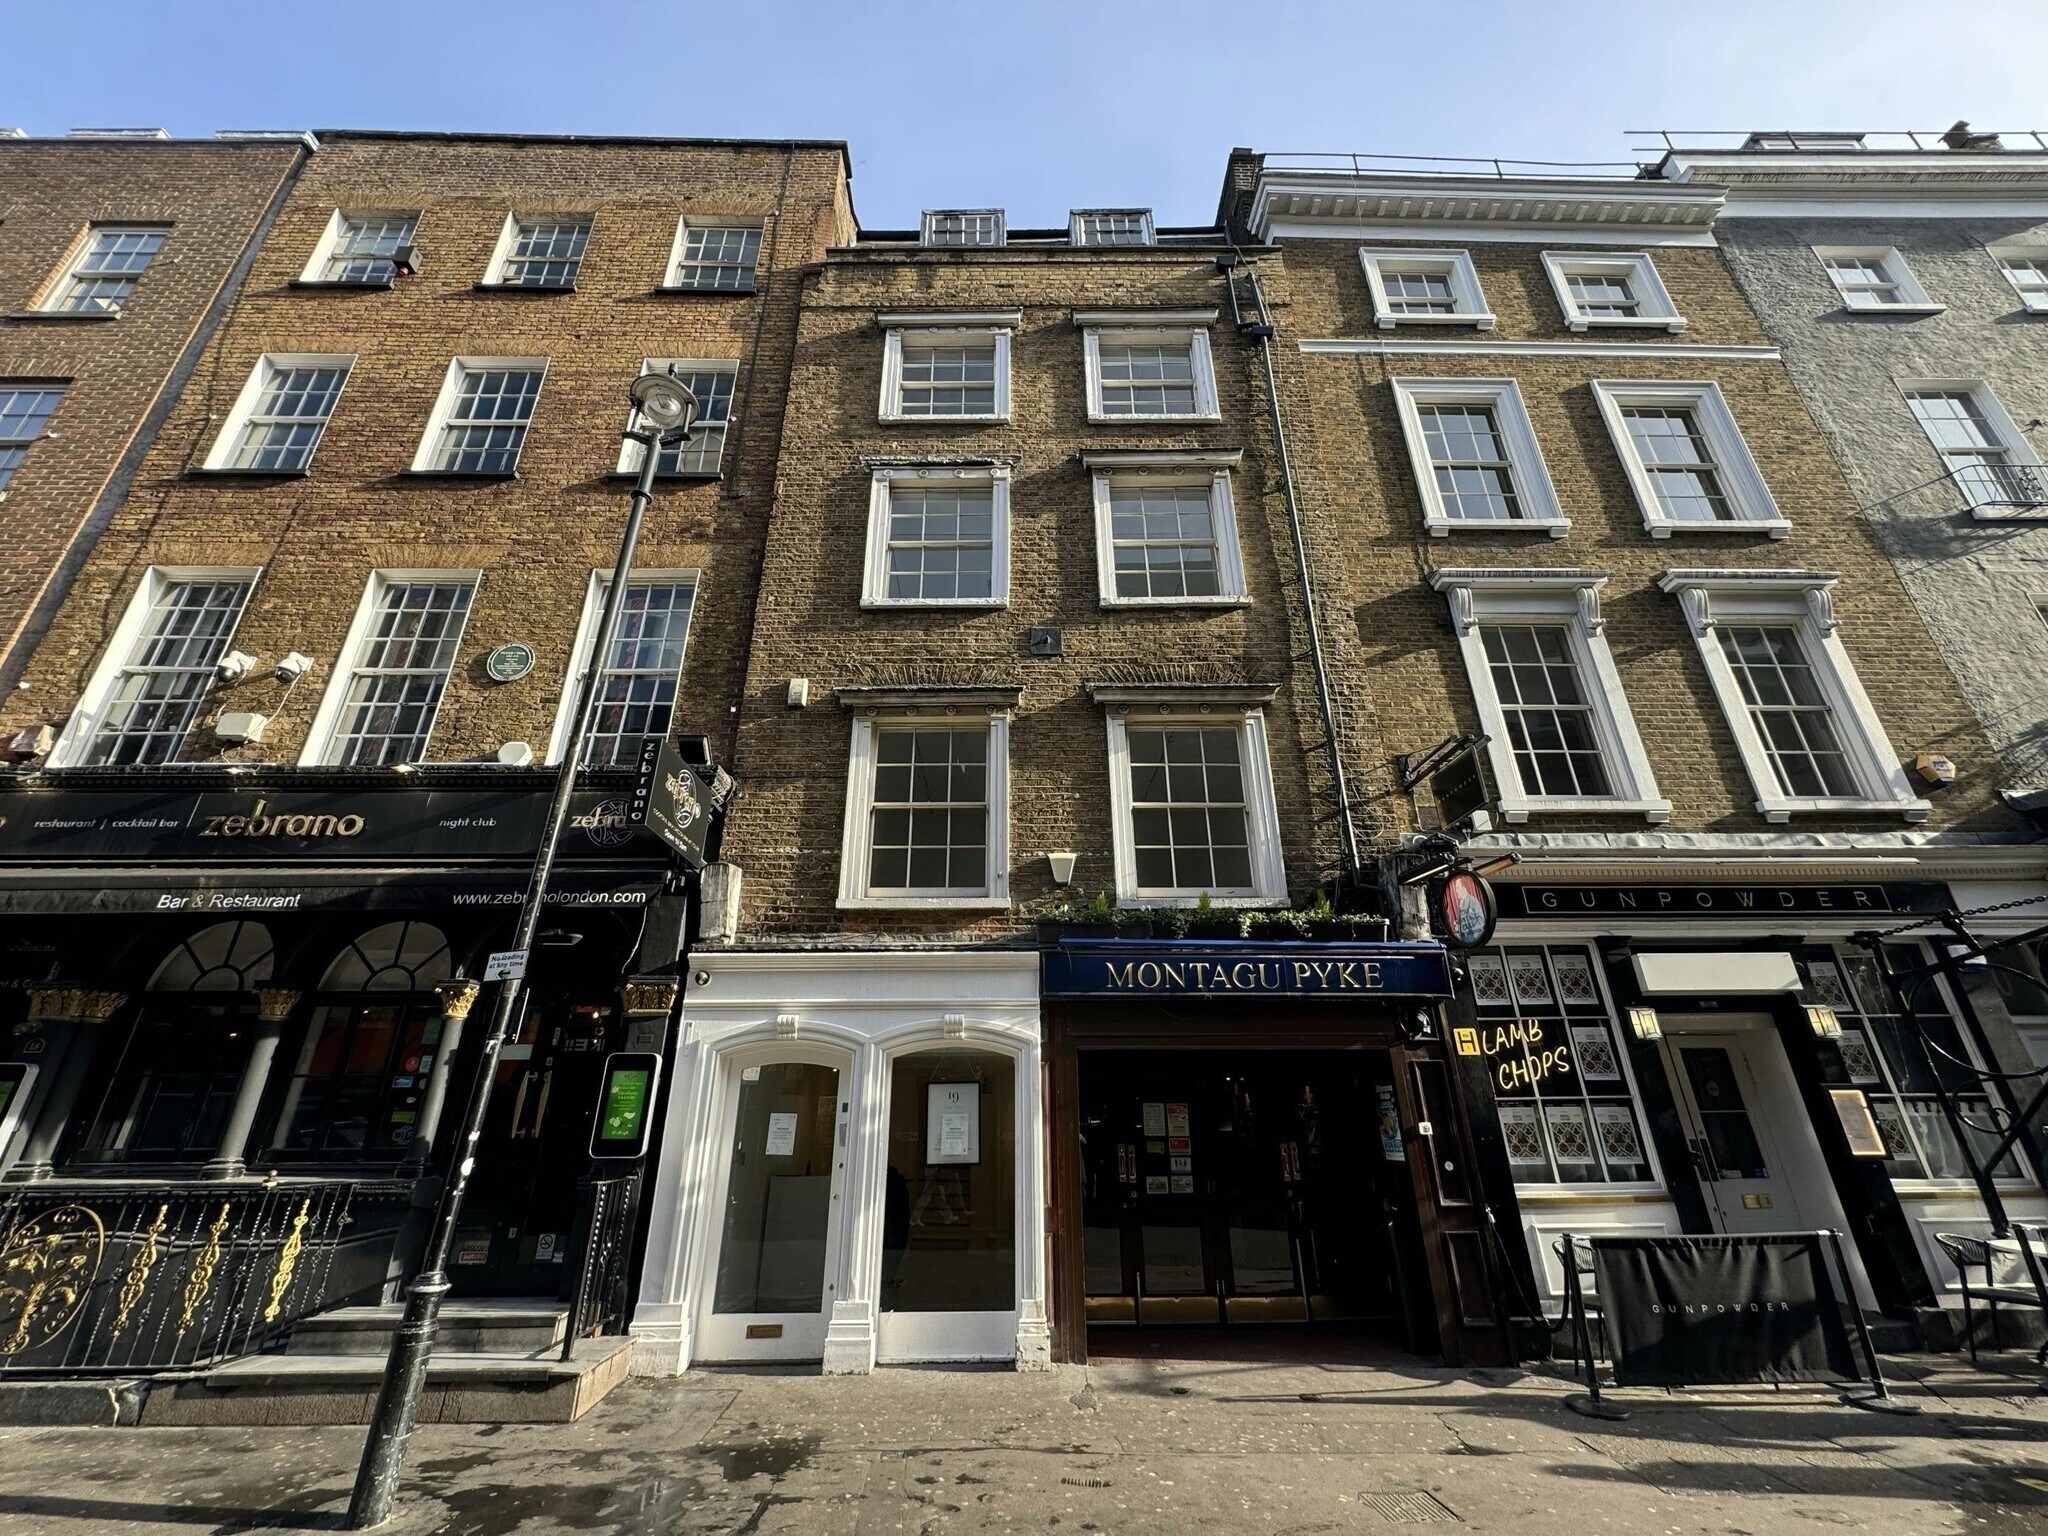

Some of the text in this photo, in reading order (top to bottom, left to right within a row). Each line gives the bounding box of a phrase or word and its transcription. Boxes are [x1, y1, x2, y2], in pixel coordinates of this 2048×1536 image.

[630, 742, 656, 820] zebrano
[34, 819, 96, 828] restaurant
[112, 818, 156, 828] cocktail
[159, 818, 181, 828] bar
[199, 799, 366, 836] zebrano
[439, 817, 497, 829] night club
[569, 807, 628, 829] zebra
[156, 893, 302, 908] Bar & Restaurant
[452, 890, 647, 905] www.zebrnolondon.com
[1541, 890, 1873, 909] GUNPOWDER
[509, 960, 524, 968] time
[1104, 961, 1385, 989] MONTAGU PYKE
[1482, 1017, 1543, 1055] LAMB
[1499, 1046, 1570, 1090] CHOPS
[948, 1091, 960, 1104] 19
[1652, 1301, 1789, 1314] GUNPOWDER
